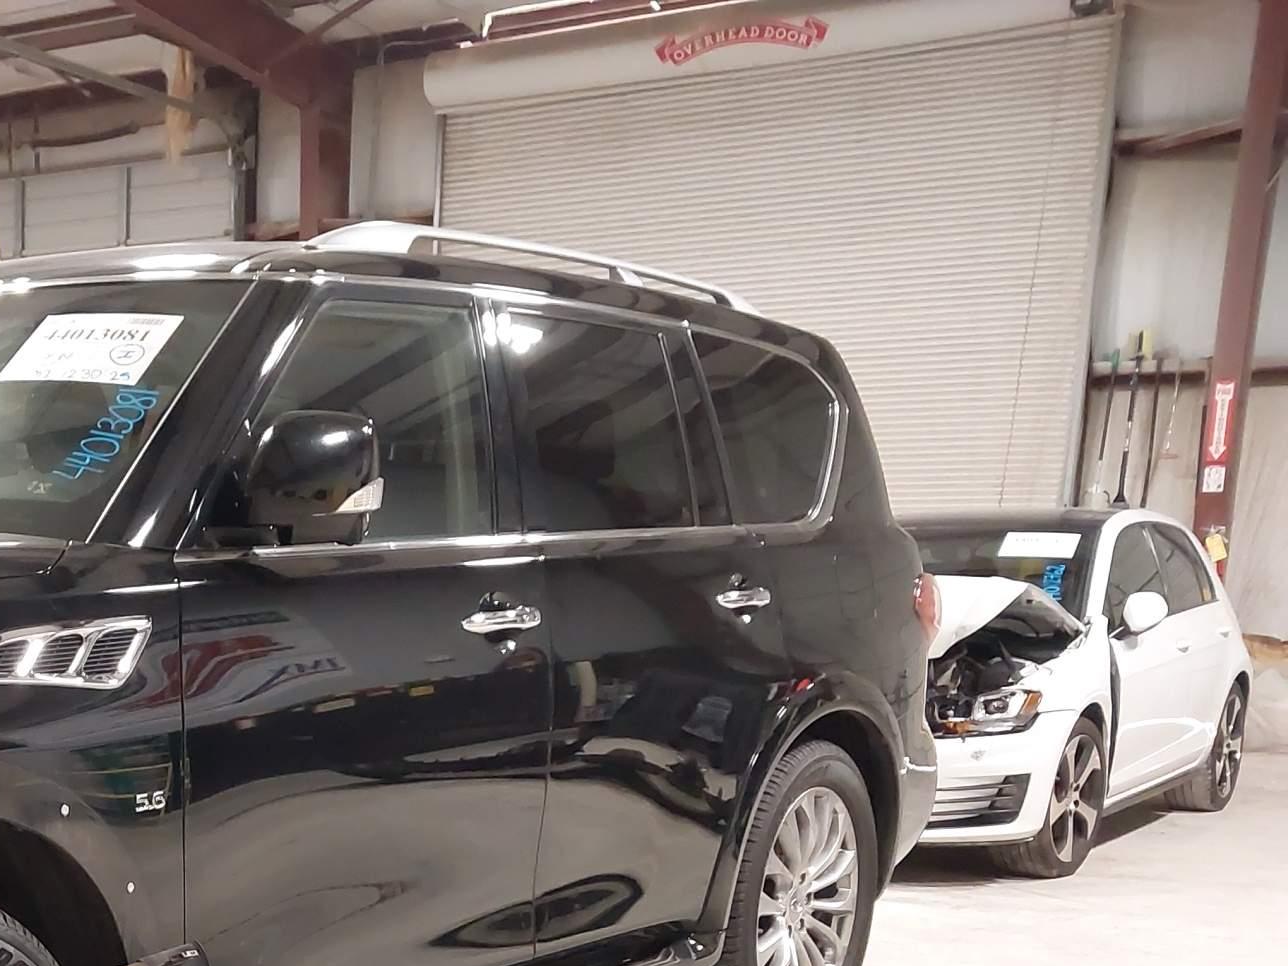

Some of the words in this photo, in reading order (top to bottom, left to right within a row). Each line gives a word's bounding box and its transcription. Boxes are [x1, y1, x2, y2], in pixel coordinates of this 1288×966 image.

[673, 26, 760, 61] OVERHEAD
[763, 26, 809, 46] DOOR
[52, 388, 160, 480] 44013081
